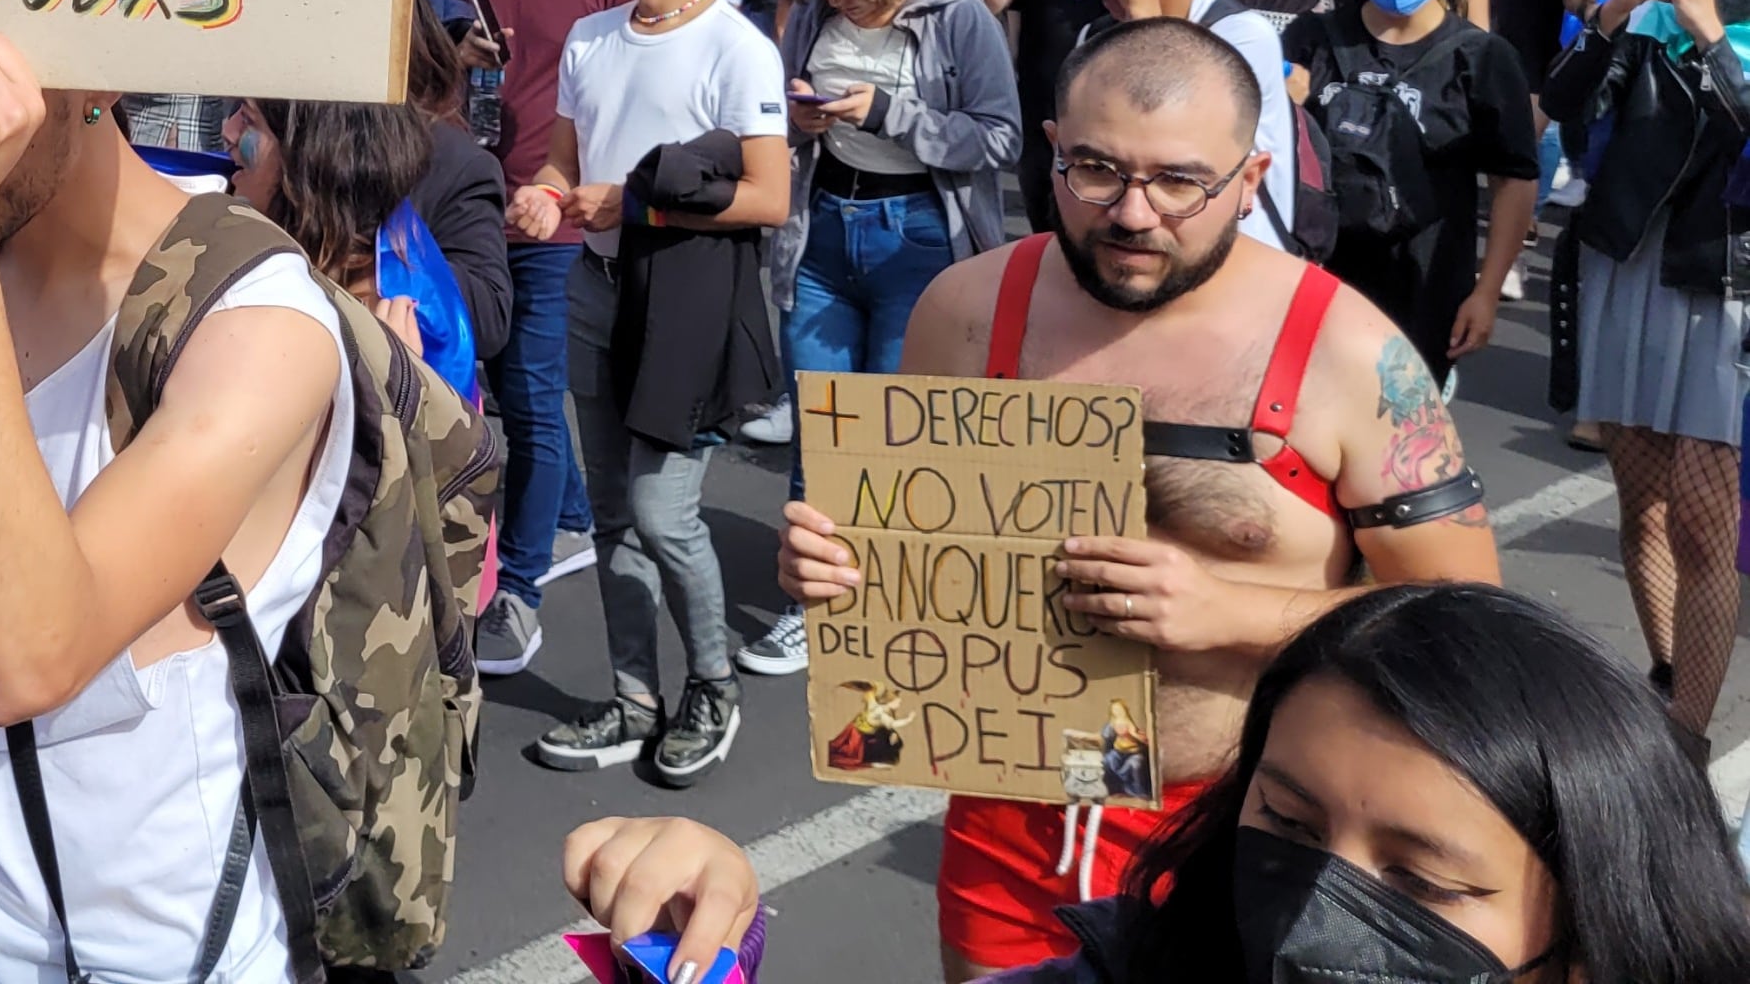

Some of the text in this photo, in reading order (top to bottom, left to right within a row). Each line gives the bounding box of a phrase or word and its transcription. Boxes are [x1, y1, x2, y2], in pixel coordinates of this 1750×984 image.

[804, 379, 1137, 462] + DERECHOS?
[851, 467, 1133, 537] NO VOTEN
[825, 533, 1116, 637] BANQUER
[819, 621, 1089, 698] DEL OPUS
[922, 702, 1062, 772] DEI
